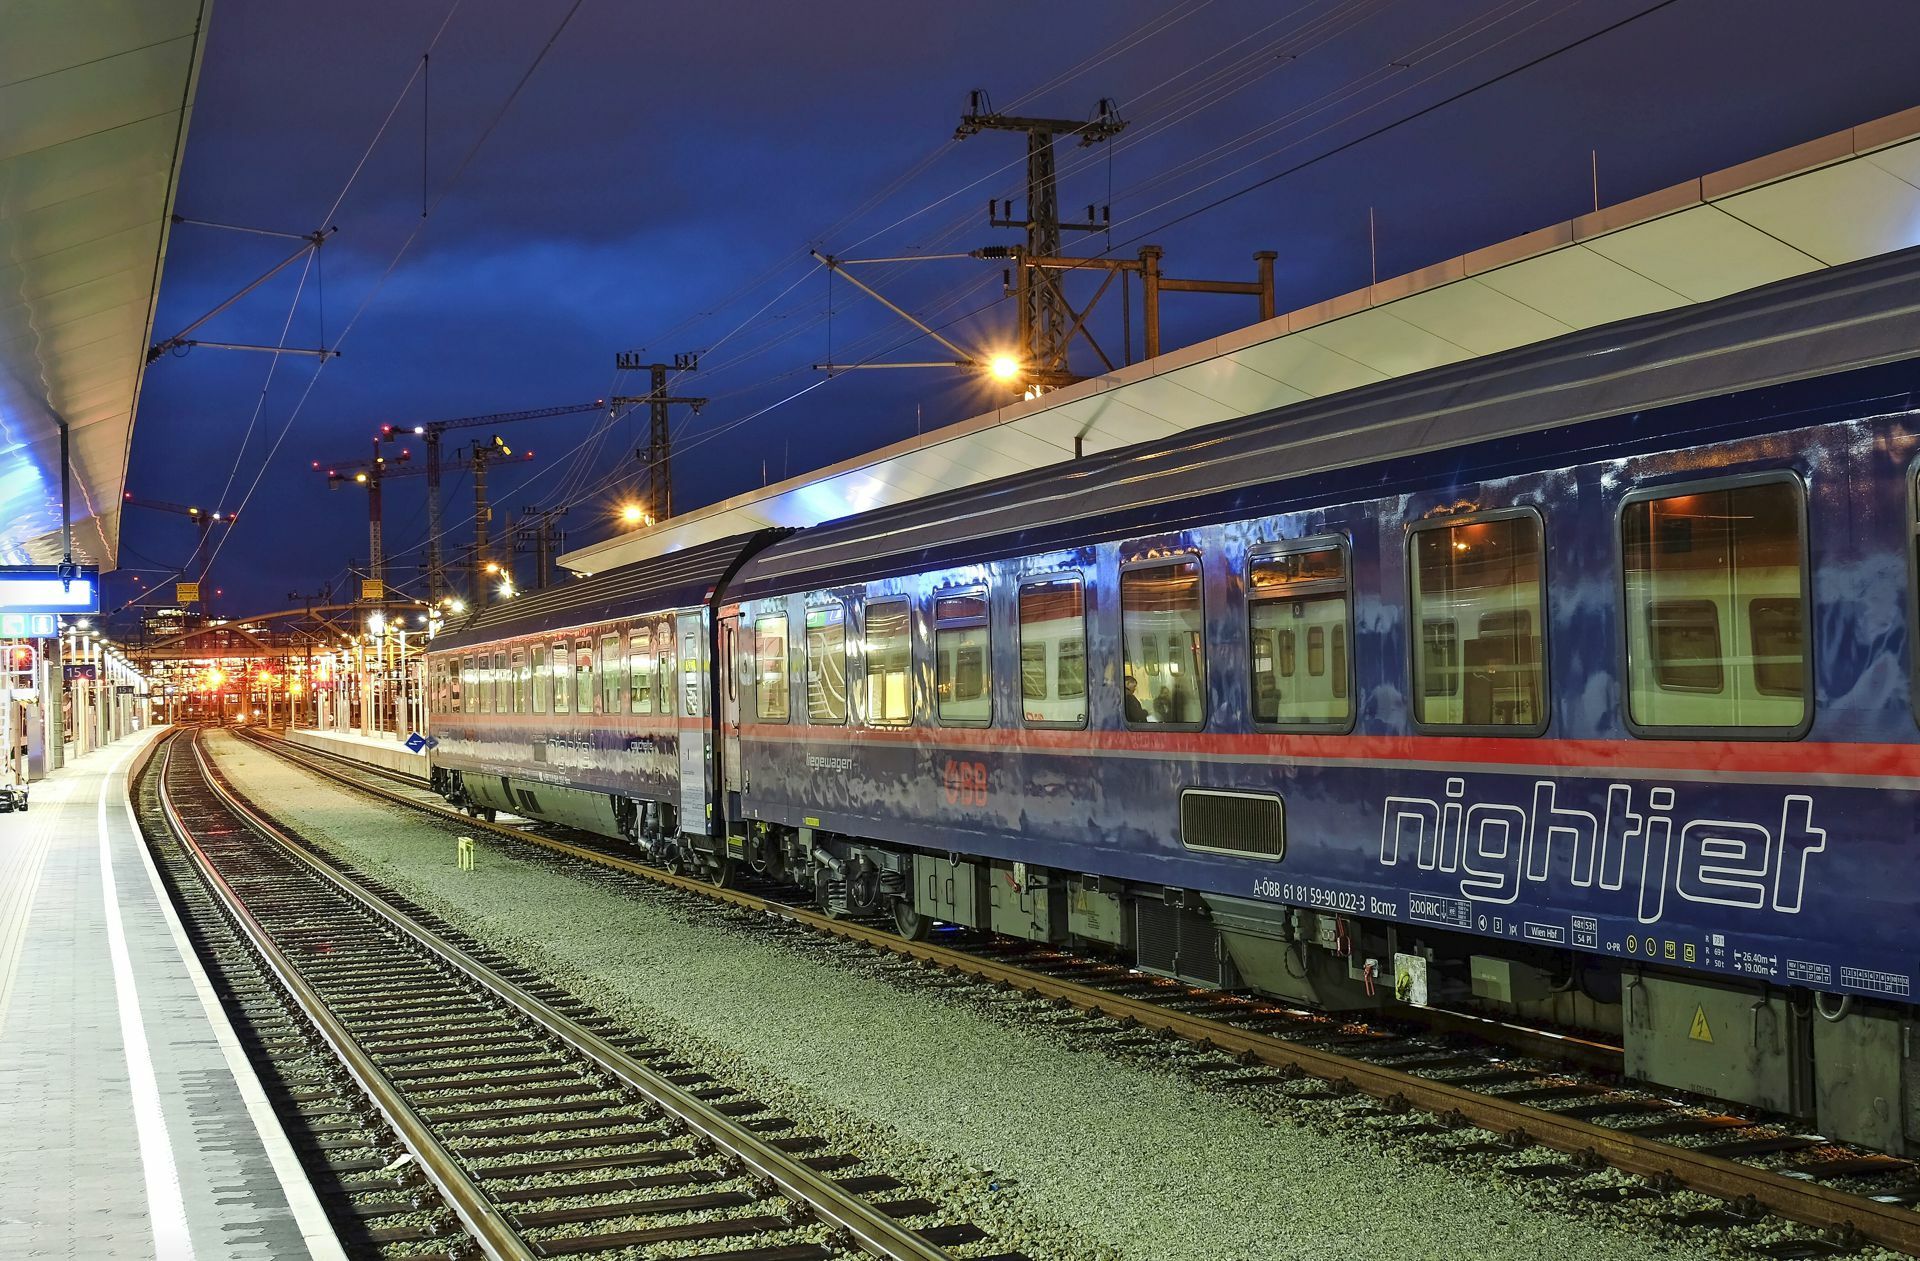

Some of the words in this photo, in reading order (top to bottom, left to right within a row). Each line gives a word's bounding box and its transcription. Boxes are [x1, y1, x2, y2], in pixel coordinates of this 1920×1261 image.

[66, 667, 82, 678] 15
[806, 753, 852, 771] liegewagen
[1380, 777, 1826, 924] nightjet
[1253, 877, 1281, 898] A-ÖBB
[1283, 884, 1294, 900] 61
[1297, 886, 1308, 902] 81
[1310, 888, 1337, 907] 59-90
[1338, 892, 1366, 912] 022-3
[1370, 896, 1397, 917] Bcmz
[1410, 899, 1426, 914] 200
[1426, 901, 1440, 917] RIC
[1531, 926, 1546, 937] Wien
[1742, 951, 1769, 965] 26.40m
[1744, 963, 1769, 975] 19.00m
